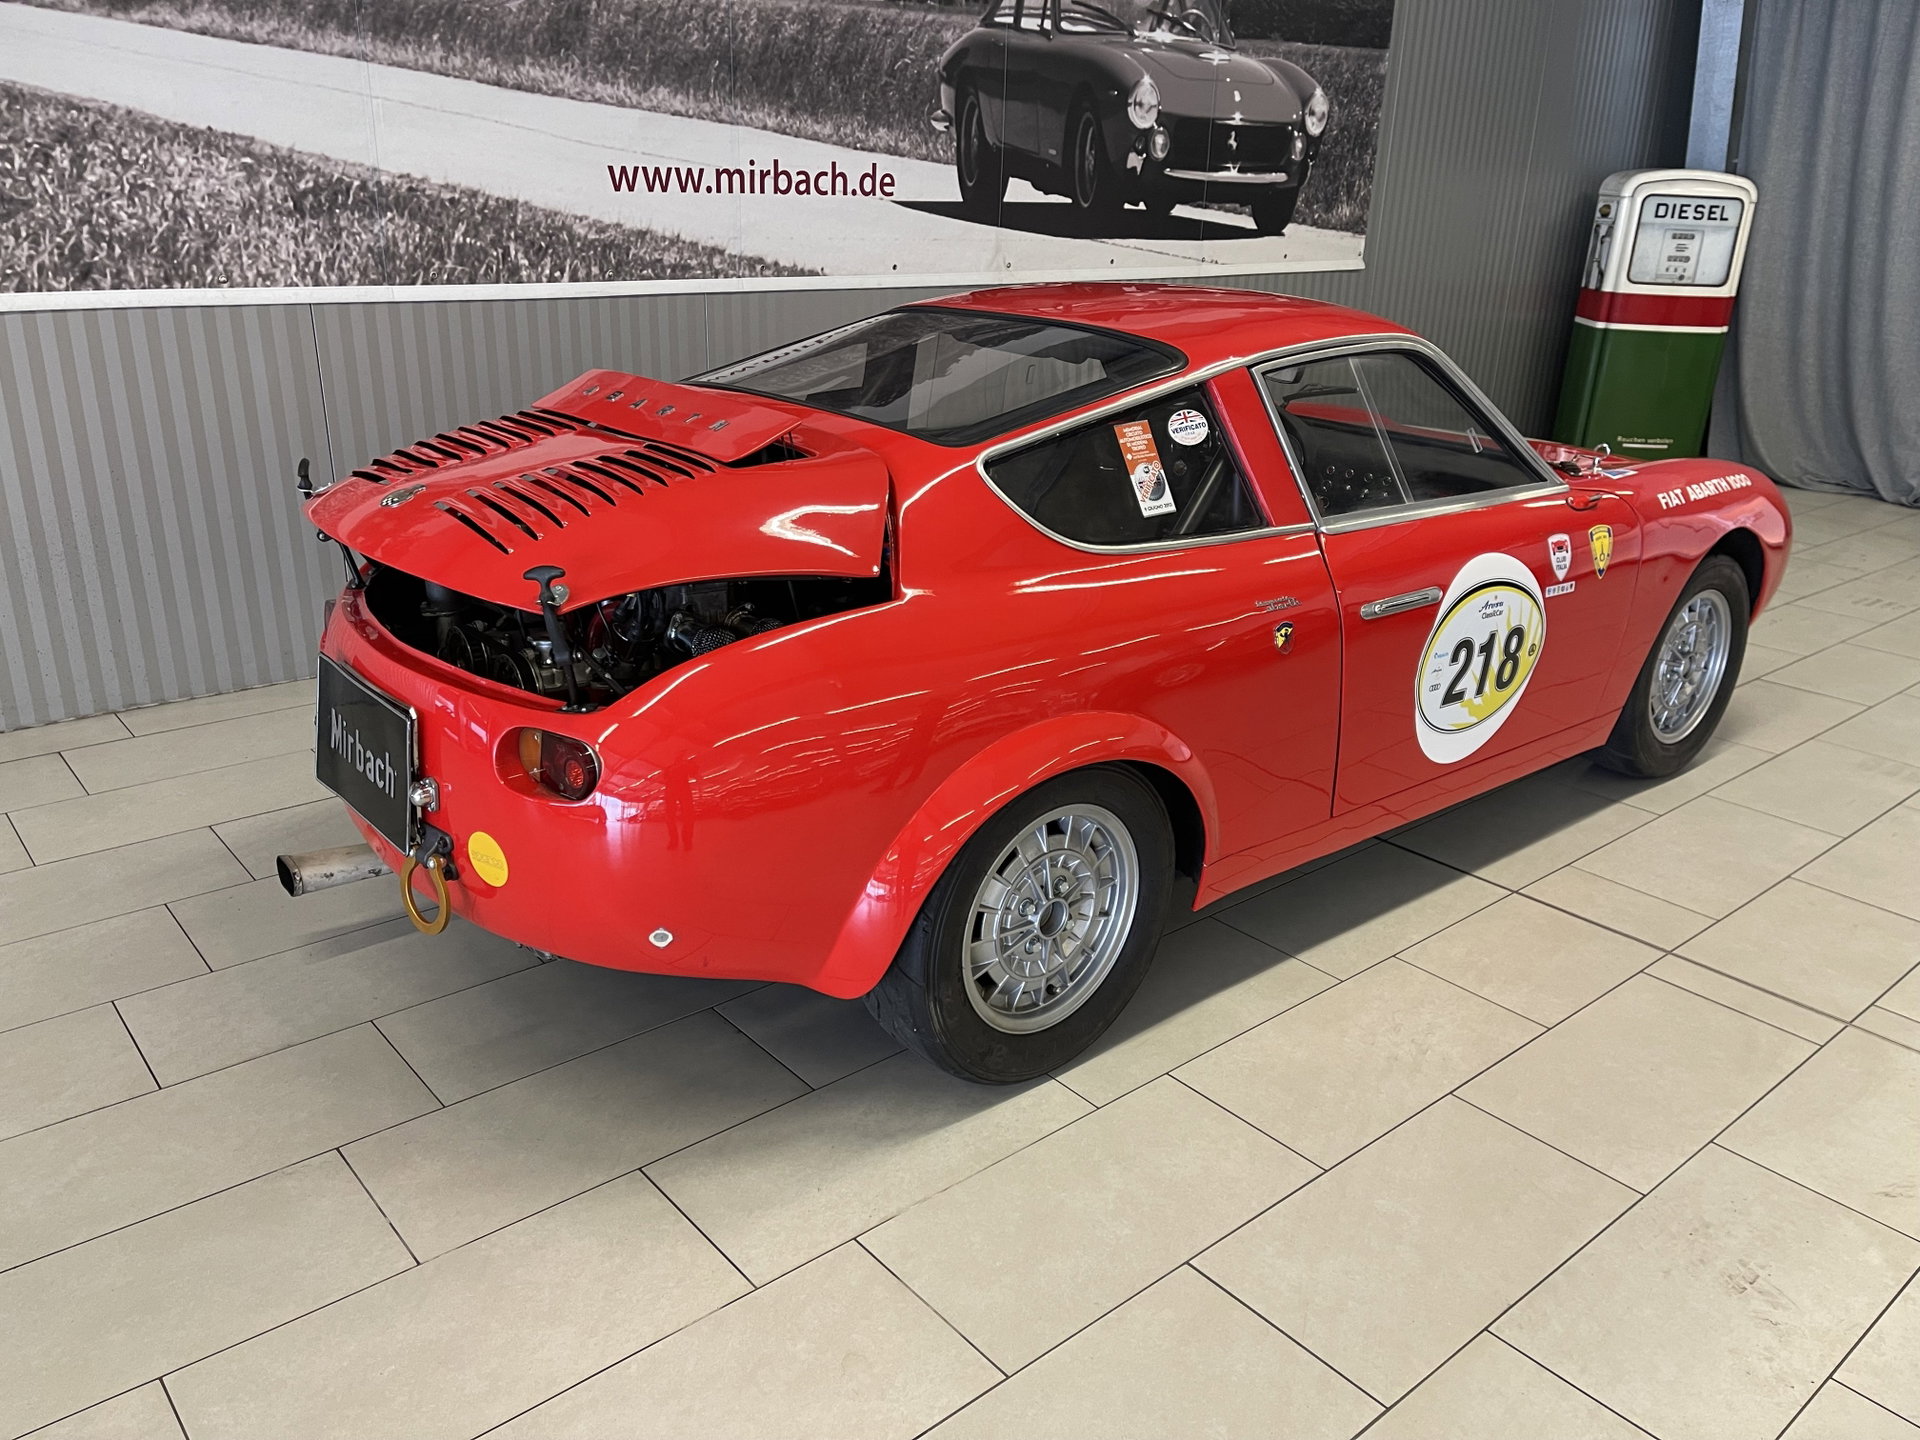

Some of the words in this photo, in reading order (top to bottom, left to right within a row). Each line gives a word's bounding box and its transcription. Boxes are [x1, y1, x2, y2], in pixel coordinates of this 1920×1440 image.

[607, 158, 896, 197] www.mirbach.de
[1654, 203, 1729, 222] DIESEL
[1171, 422, 1206, 434] VERIFICATO
[1140, 461, 1160, 503] VERIFICATO
[1657, 488, 1686, 510] FIAT
[1686, 477, 1731, 502] ABARTH
[1440, 624, 1526, 709] 218
[330, 707, 395, 799] Mirbach
